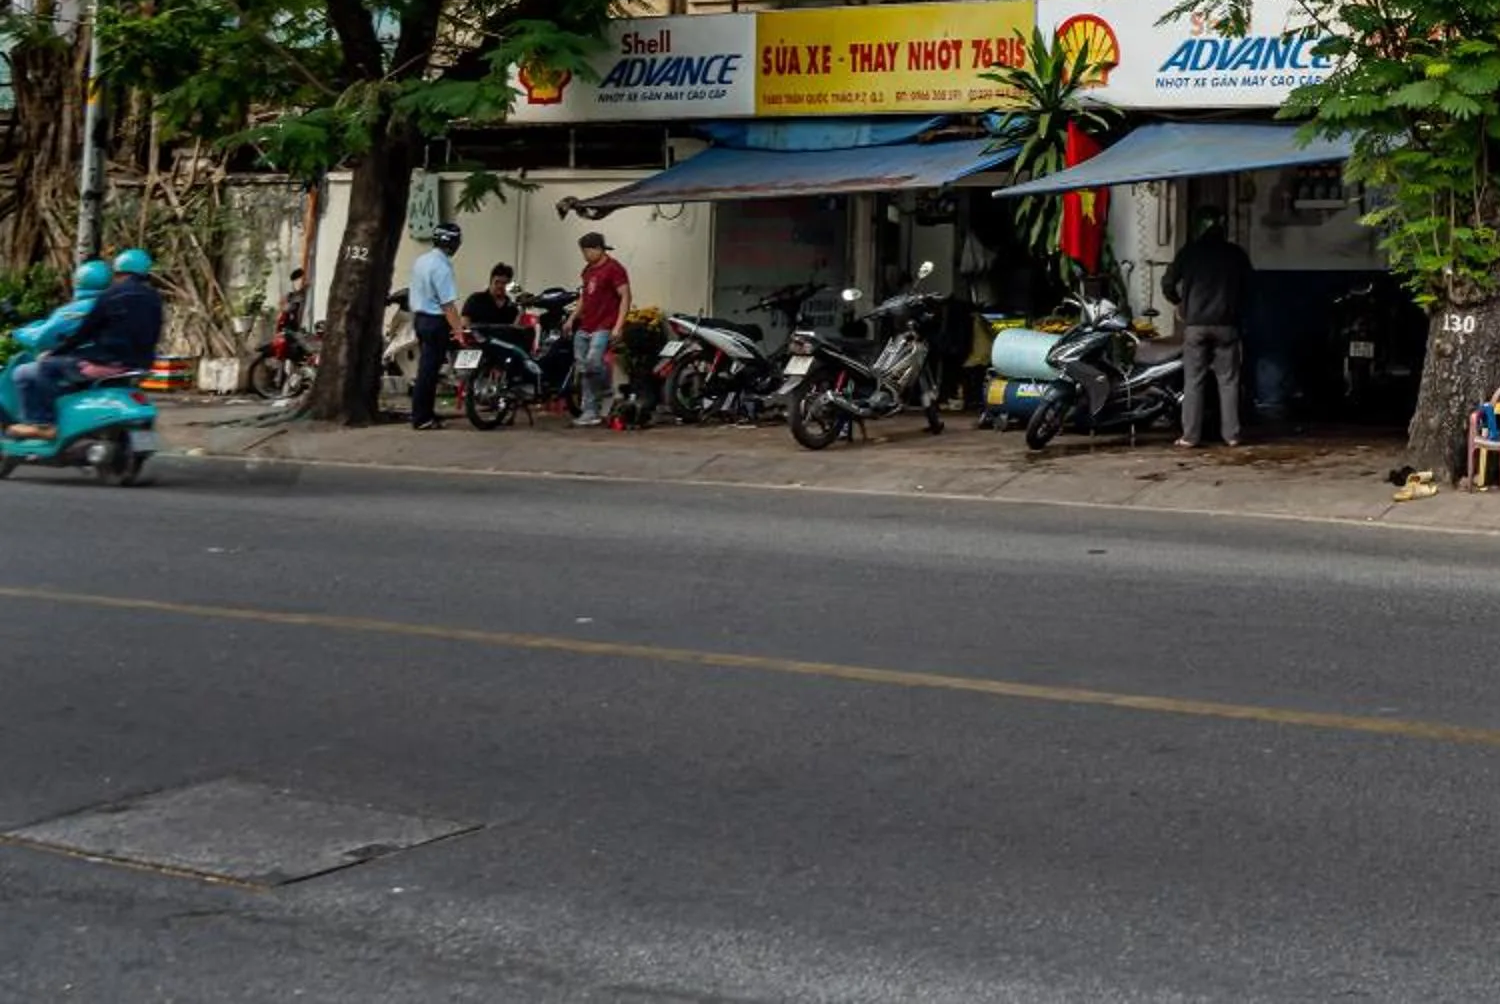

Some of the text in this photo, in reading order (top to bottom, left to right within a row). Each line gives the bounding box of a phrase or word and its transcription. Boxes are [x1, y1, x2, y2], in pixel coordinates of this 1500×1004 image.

[621, 29, 671, 55] Shell
[598, 54, 743, 88] ADVANCE
[806, 44, 832, 75] XE
[849, 41, 900, 73] THAY
[345, 246, 369, 261] 132
[1442, 313, 1475, 333] 130
